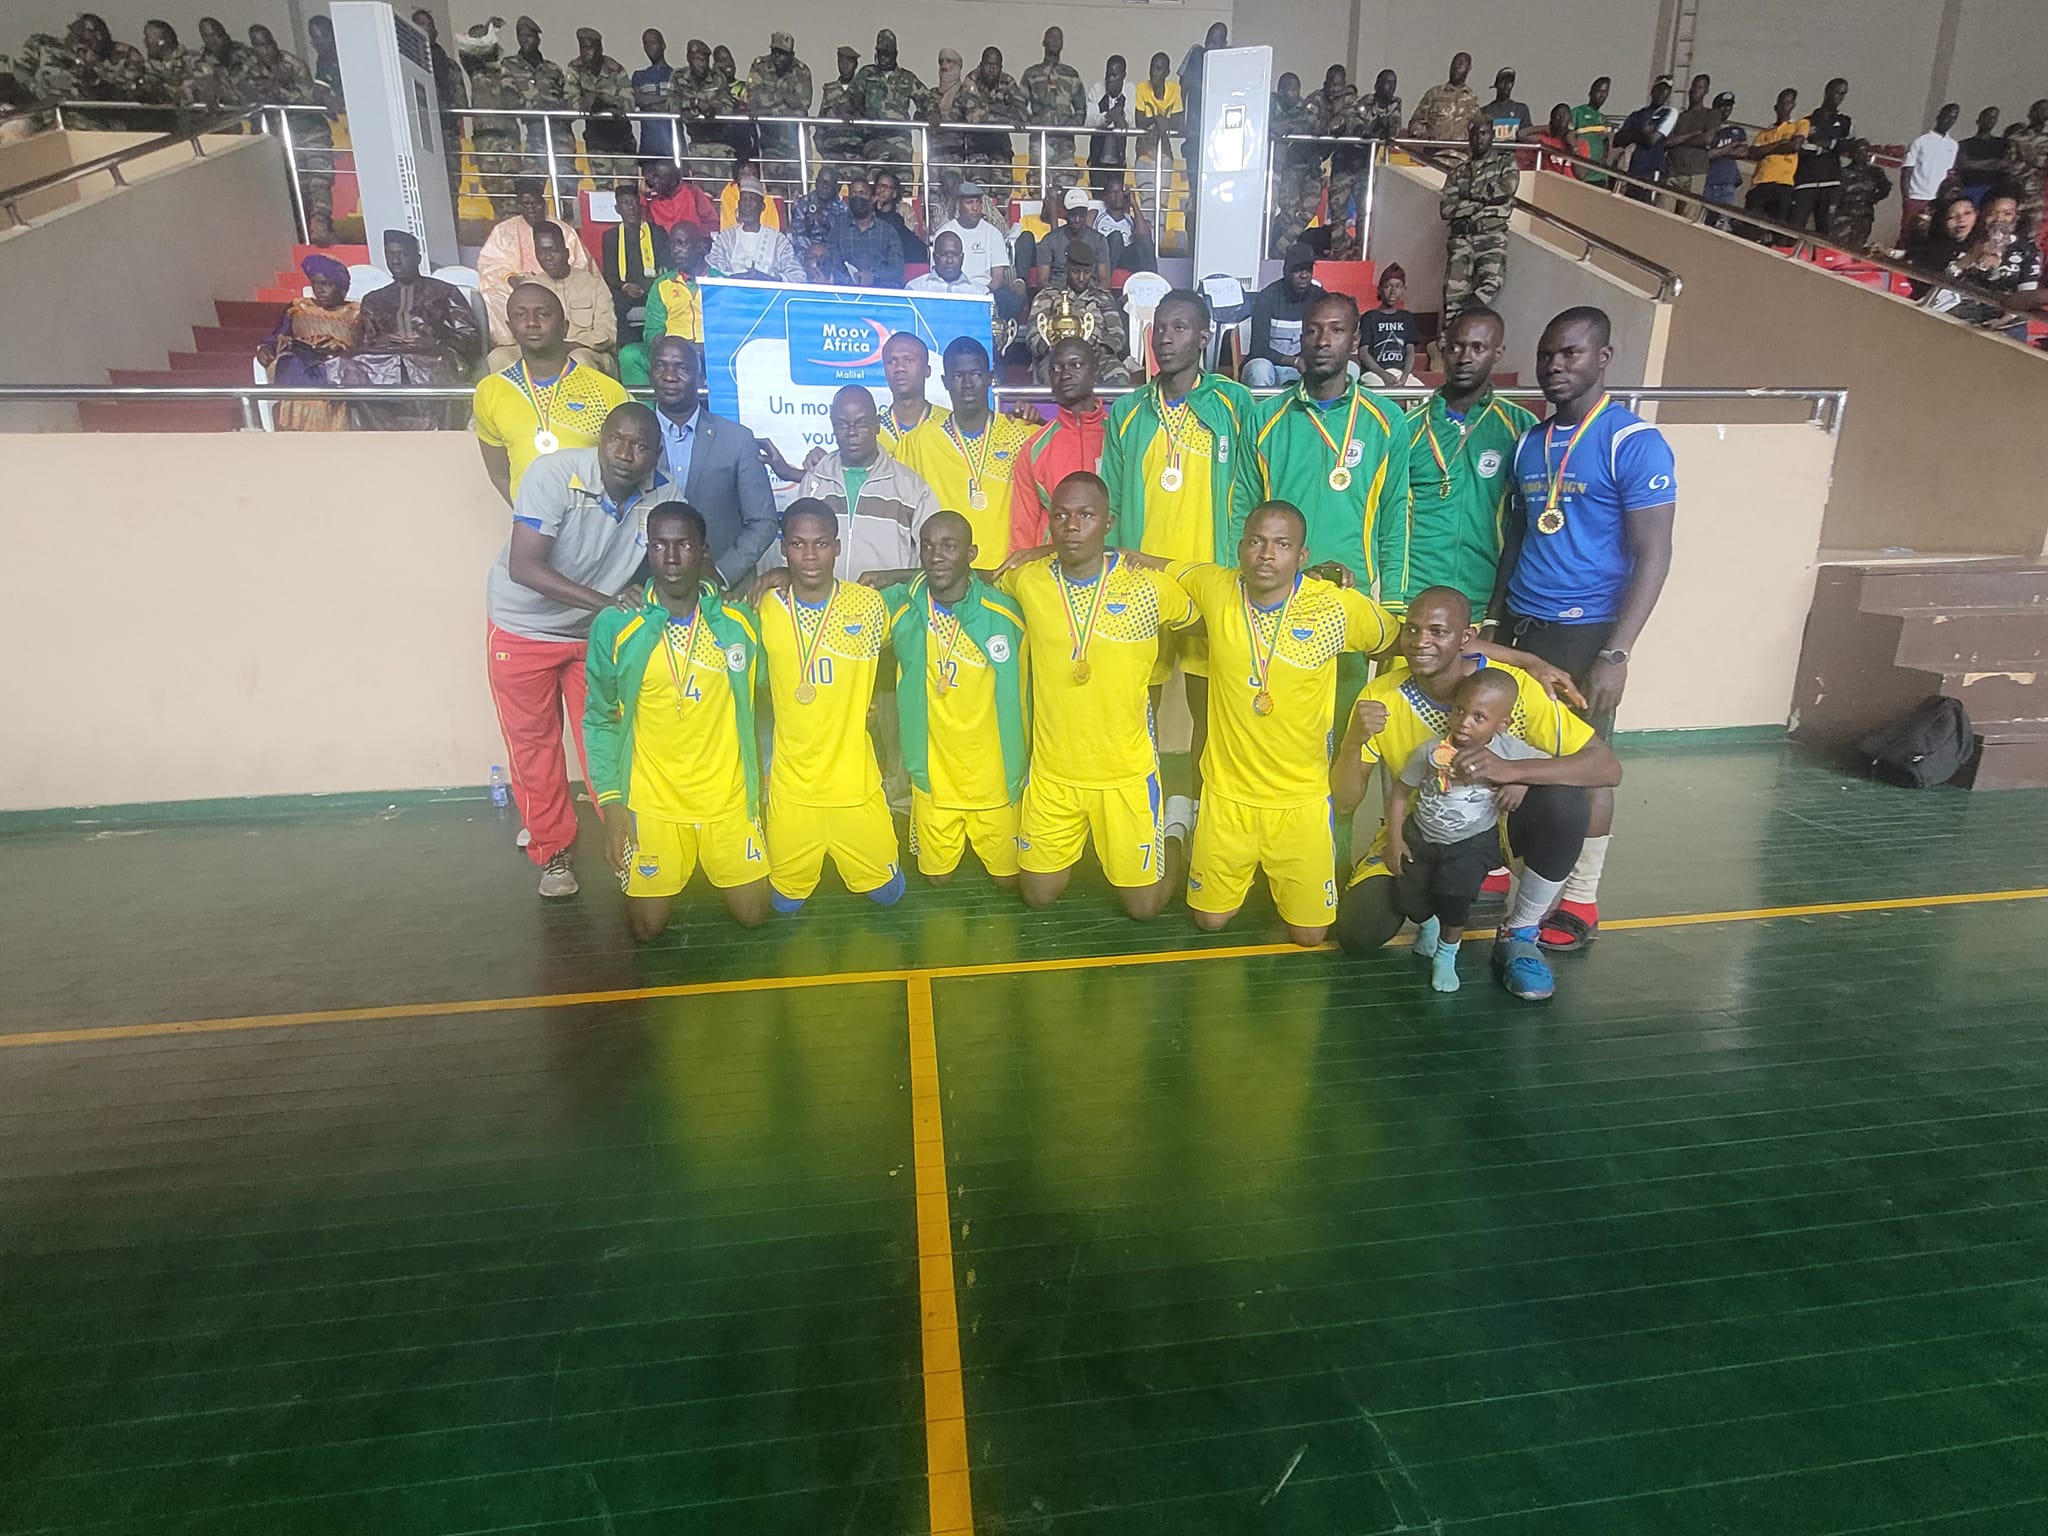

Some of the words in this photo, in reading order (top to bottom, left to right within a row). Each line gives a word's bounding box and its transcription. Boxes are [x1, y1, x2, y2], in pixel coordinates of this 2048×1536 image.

[822, 323, 870, 339] Moov
[1377, 322, 1405, 332] PINK
[823, 337, 870, 353] Africa
[835, 370, 865, 379] Malitel
[769, 395, 795, 415] Un
[801, 402, 833, 416] mo
[801, 432, 835, 445] vou
[809, 656, 834, 685] 10
[936, 660, 958, 688] 12
[684, 674, 702, 702] 4
[745, 836, 763, 863] 4
[1139, 843, 1152, 872] 7
[1324, 878, 1334, 908] 3
